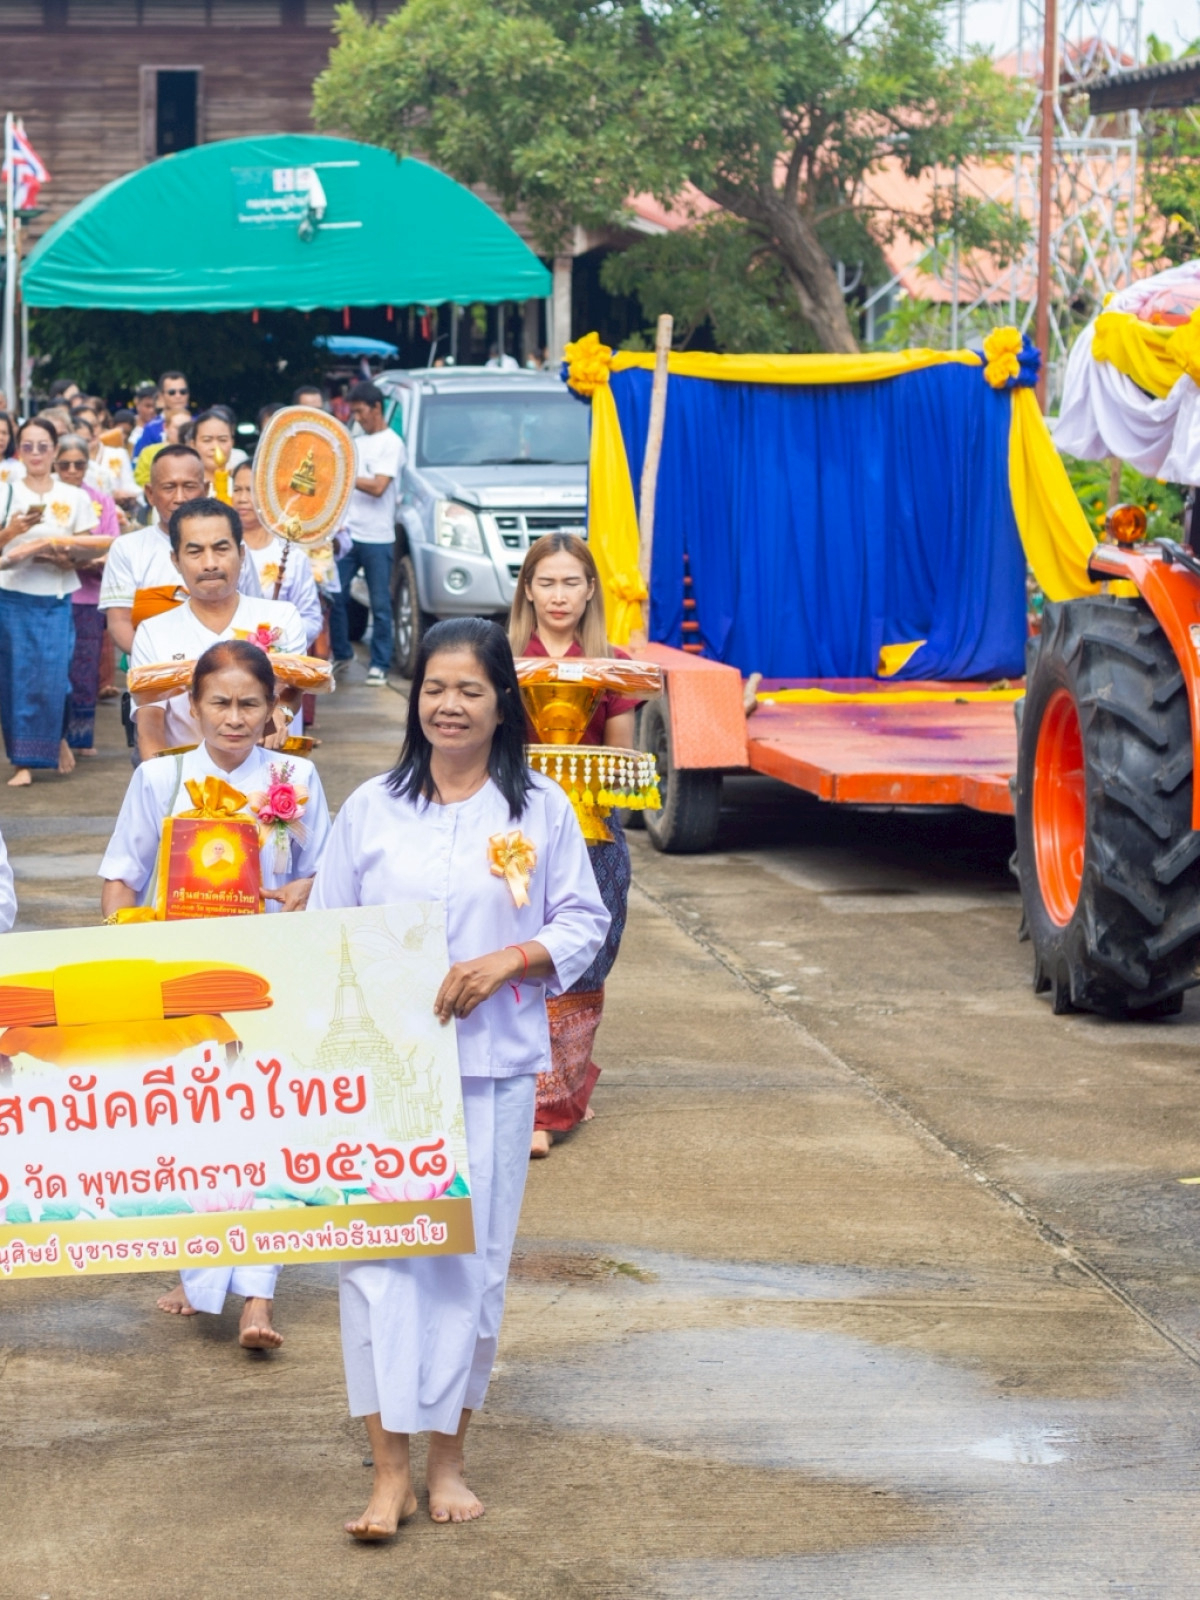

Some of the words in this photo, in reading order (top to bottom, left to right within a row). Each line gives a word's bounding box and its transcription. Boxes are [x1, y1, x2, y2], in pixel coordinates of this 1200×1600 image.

[24, 1163, 68, 1200] วัด
[78, 1155, 267, 1210] พุทธศักราช
[280, 1137, 449, 1185] ๒๕๖๘
[68, 1240, 178, 1269] บูชาธรรม
[186, 1239, 221, 1255] ๘๑
[229, 1227, 246, 1253] ปี
[255, 1217, 447, 1251] หลวงพ่อธัมมชโย
